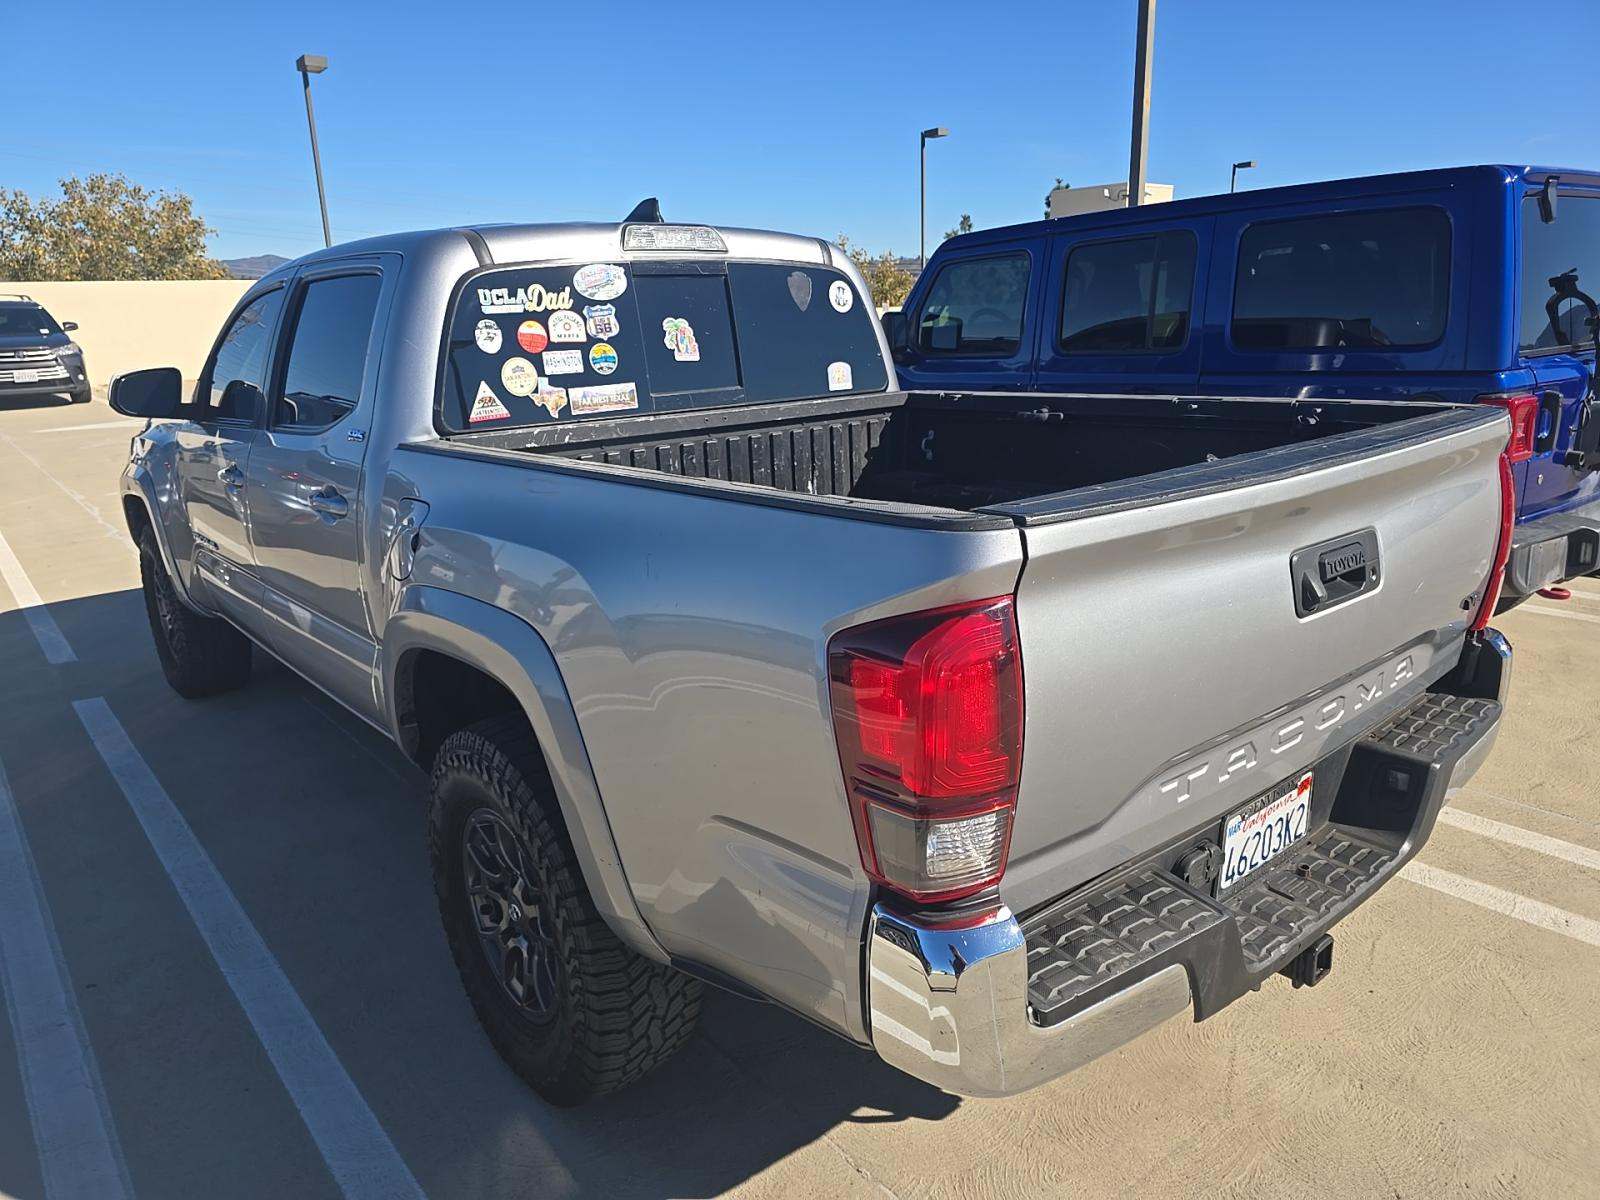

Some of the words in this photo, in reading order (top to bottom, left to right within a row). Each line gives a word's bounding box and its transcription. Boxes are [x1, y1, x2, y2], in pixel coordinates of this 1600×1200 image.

[478, 288, 528, 306] UCLA
[525, 284, 573, 312] Dad
[595, 323, 612, 334] 66
[1327, 550, 1366, 574] TOYOTA
[1160, 654, 1415, 804] TACOMA
[1225, 802, 1305, 883] 46203K2
